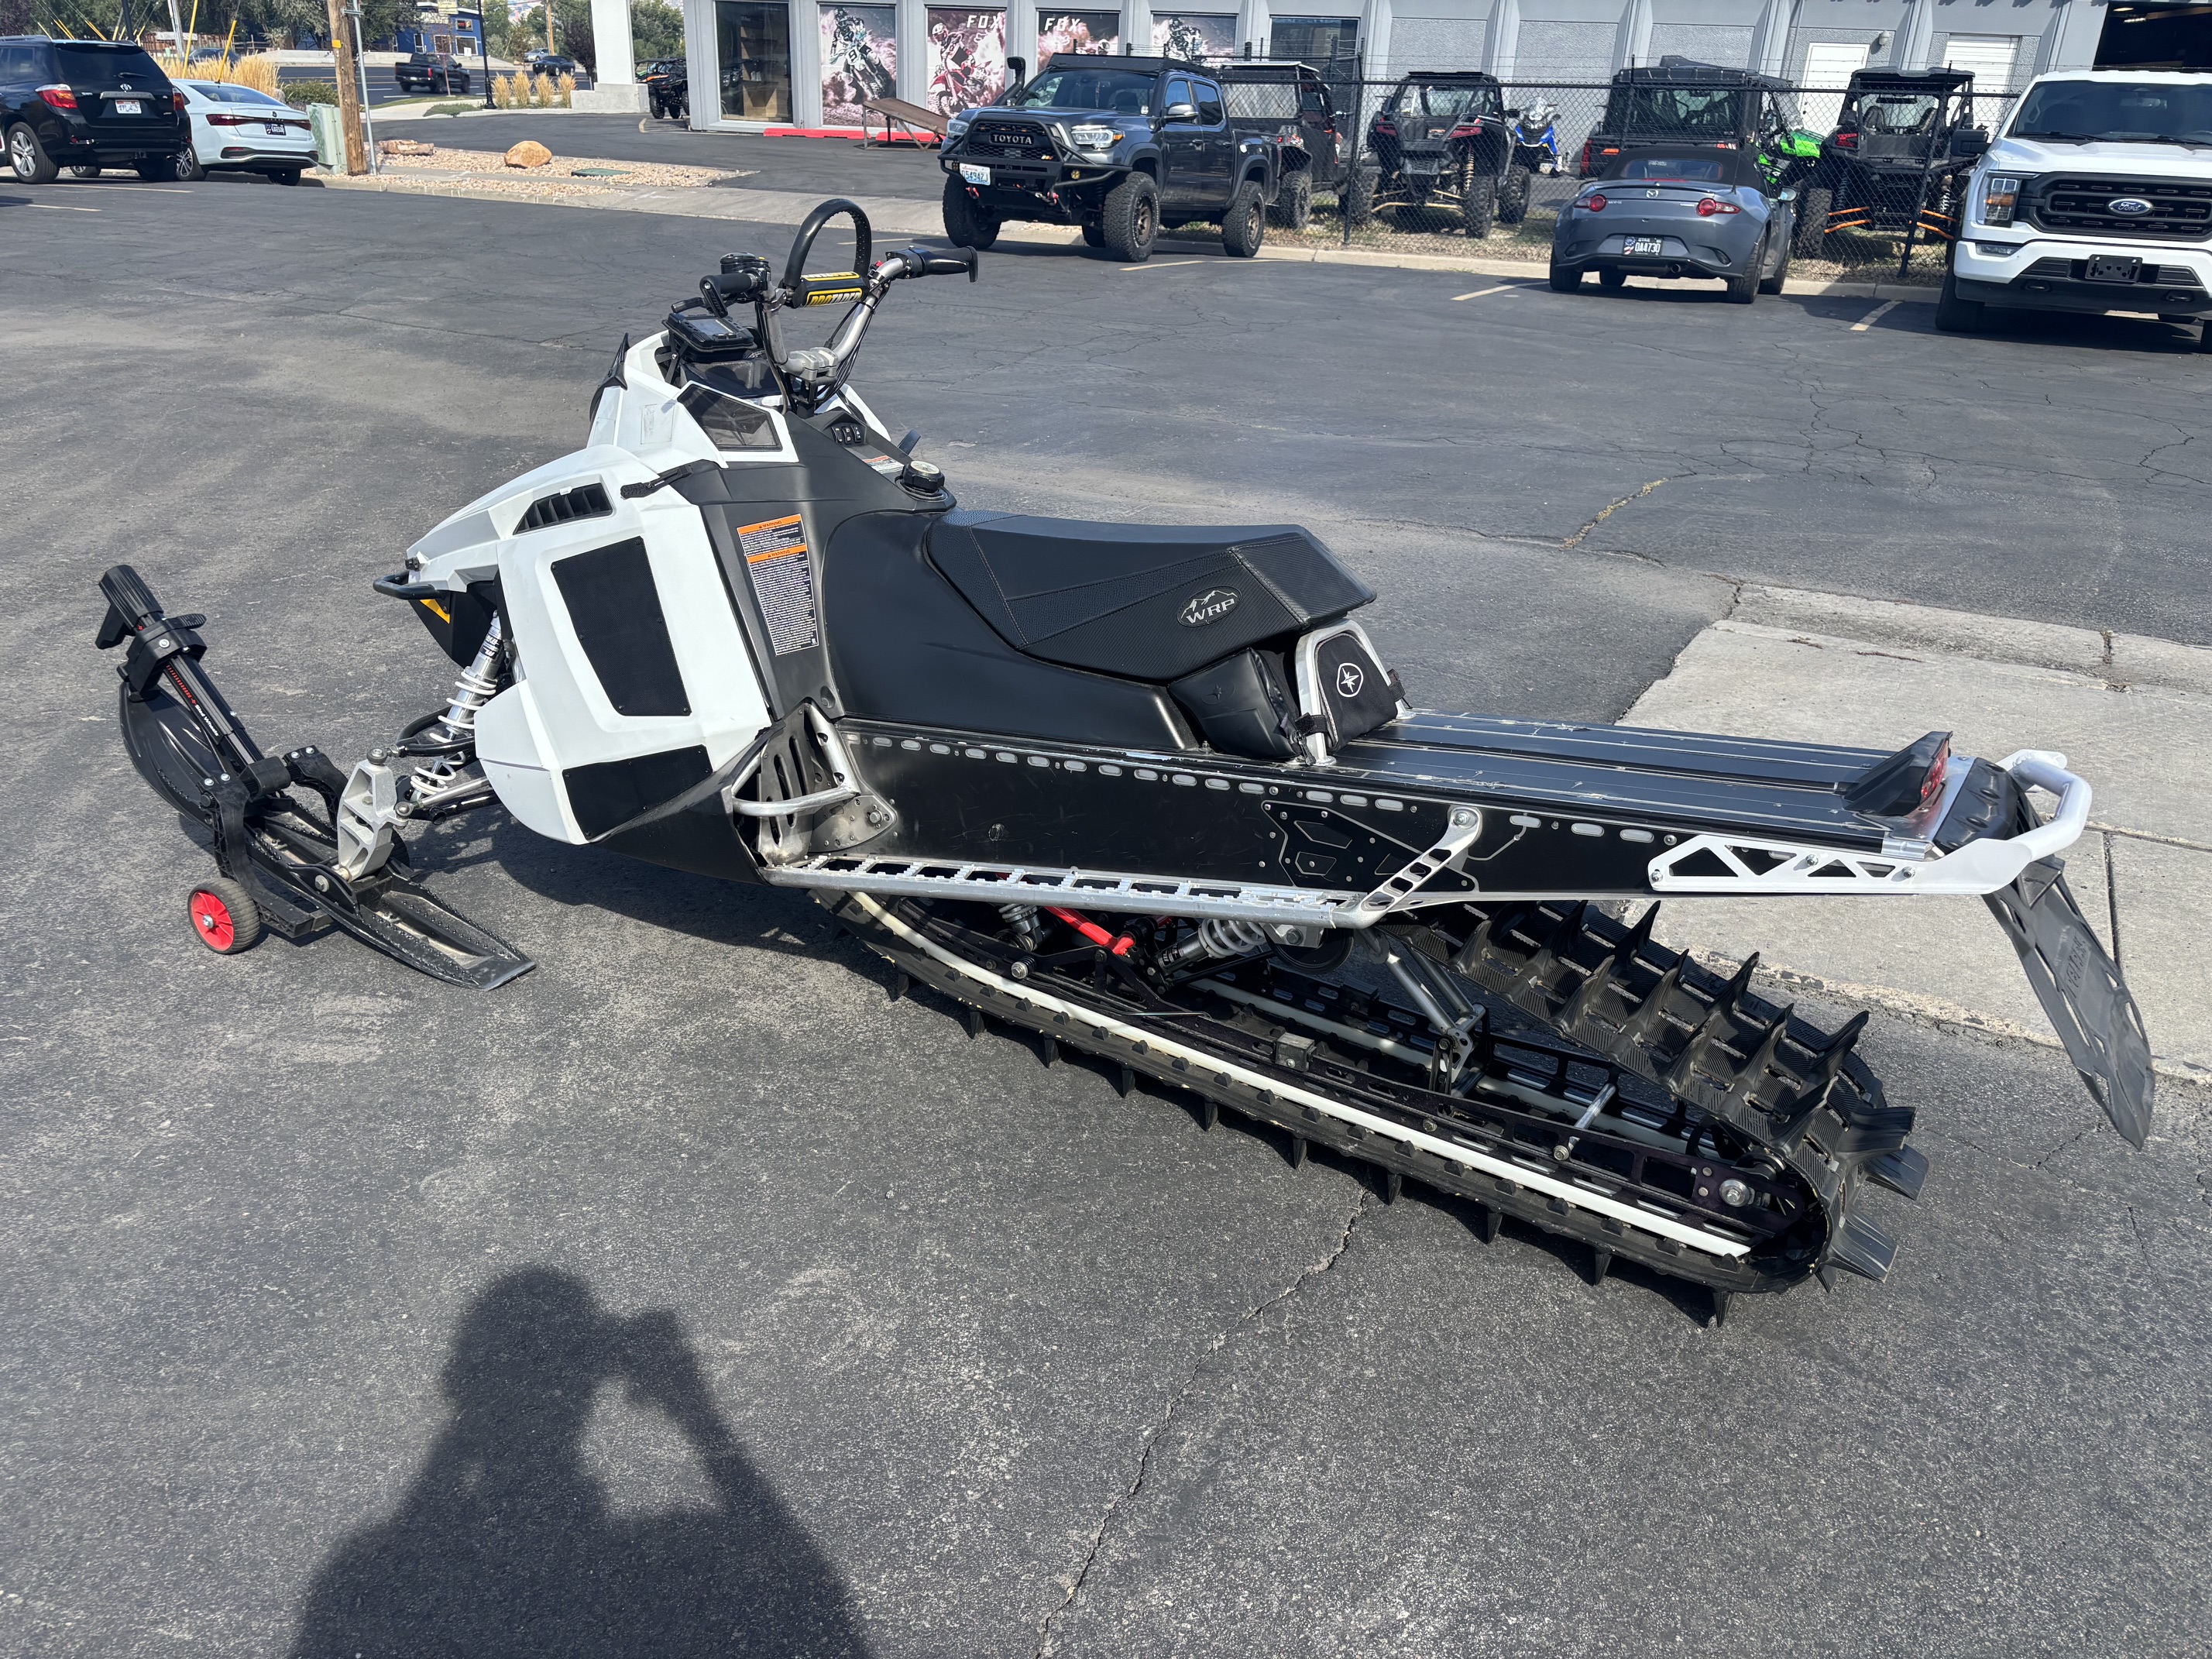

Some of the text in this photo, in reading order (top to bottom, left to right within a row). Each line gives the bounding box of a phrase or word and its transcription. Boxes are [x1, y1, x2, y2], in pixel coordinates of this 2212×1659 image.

[967, 15, 1000, 29] FOX
[1044, 18, 1080, 32] FOX
[848, 49, 857, 63] 9
[992, 134, 1032, 145] TOYOTA
[2118, 201, 2142, 211] Ford
[1186, 598, 1235, 624] WRP
